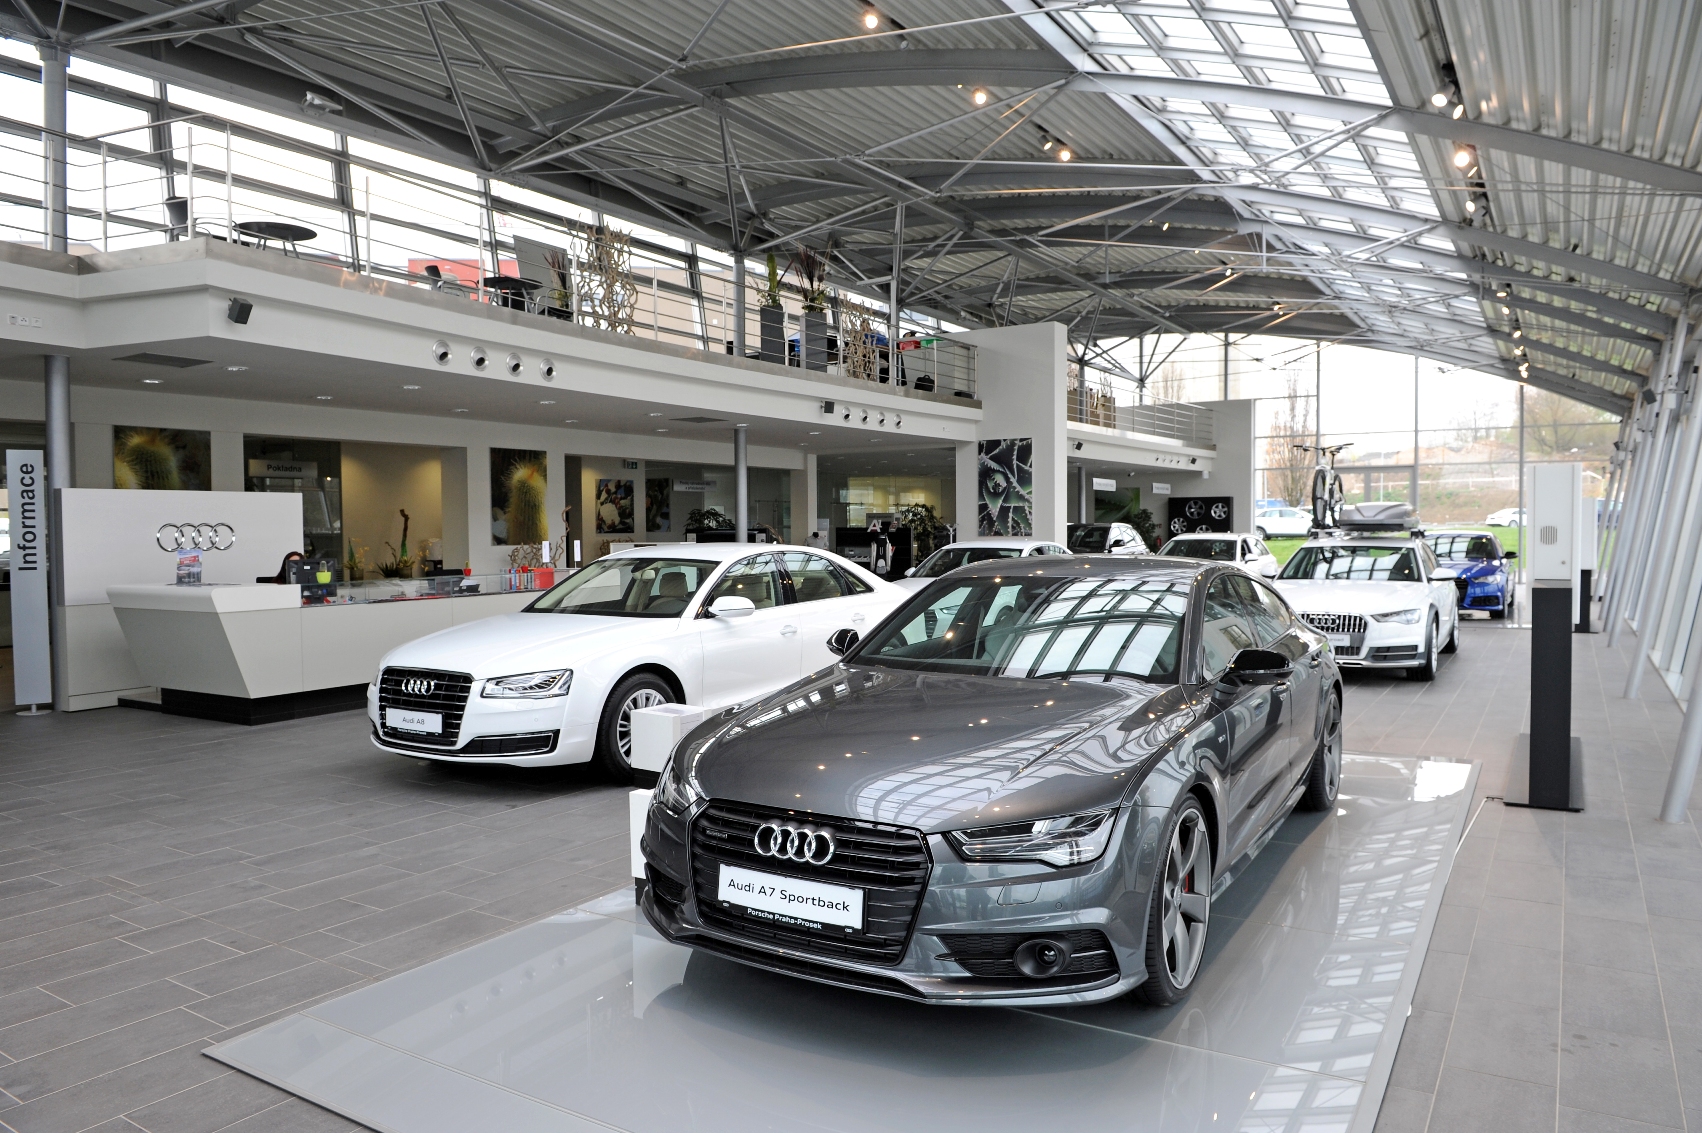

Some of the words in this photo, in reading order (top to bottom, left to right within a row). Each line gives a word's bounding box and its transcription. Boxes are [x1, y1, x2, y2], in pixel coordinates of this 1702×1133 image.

[267, 464, 302, 473] Pokladna
[17, 463, 38, 571] Informace
[727, 878, 755, 894] Audi
[757, 885, 776, 897] A7
[779, 889, 851, 912] Sportback
[747, 907, 774, 920] Porsche
[774, 914, 822, 930] Praha-Prosek
